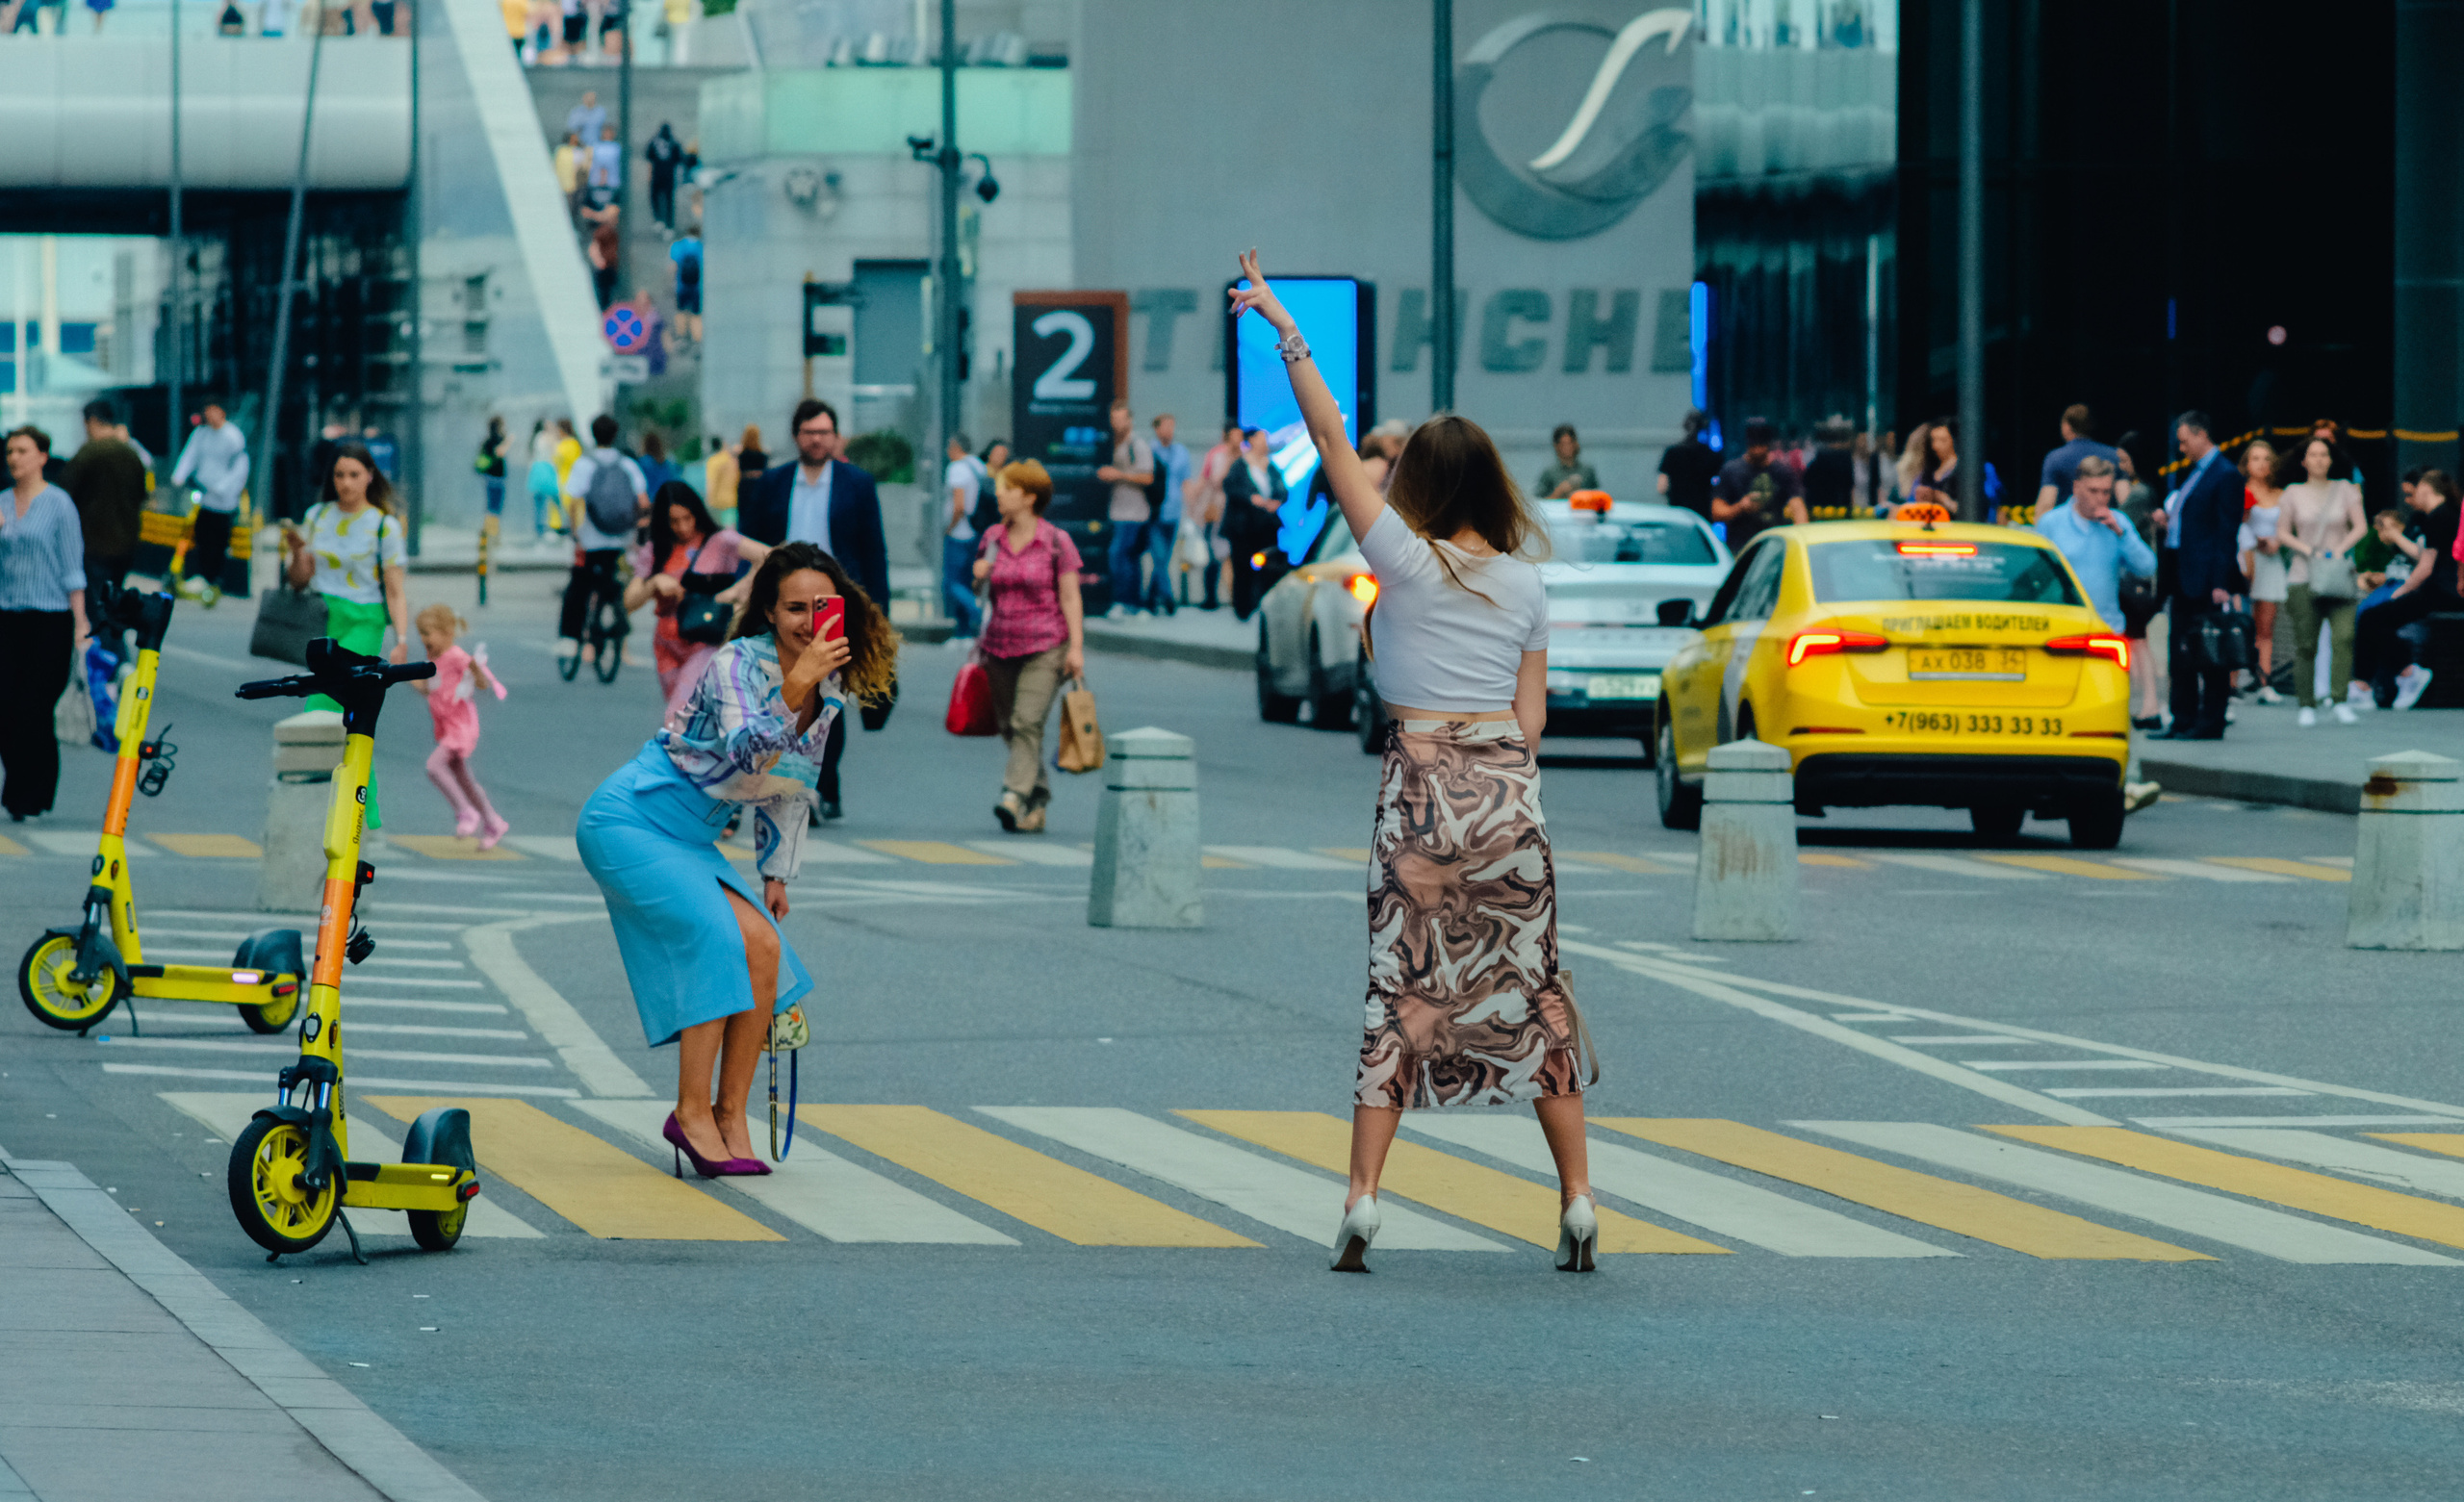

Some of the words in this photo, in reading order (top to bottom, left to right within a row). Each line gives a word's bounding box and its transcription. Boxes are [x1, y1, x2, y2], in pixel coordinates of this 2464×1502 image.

[1032, 310, 1096, 398] 2
[1949, 651, 1986, 670] 038
[1967, 715, 2003, 733] 333
[2011, 717, 2034, 734] 33
[2040, 718, 2063, 736] 33
